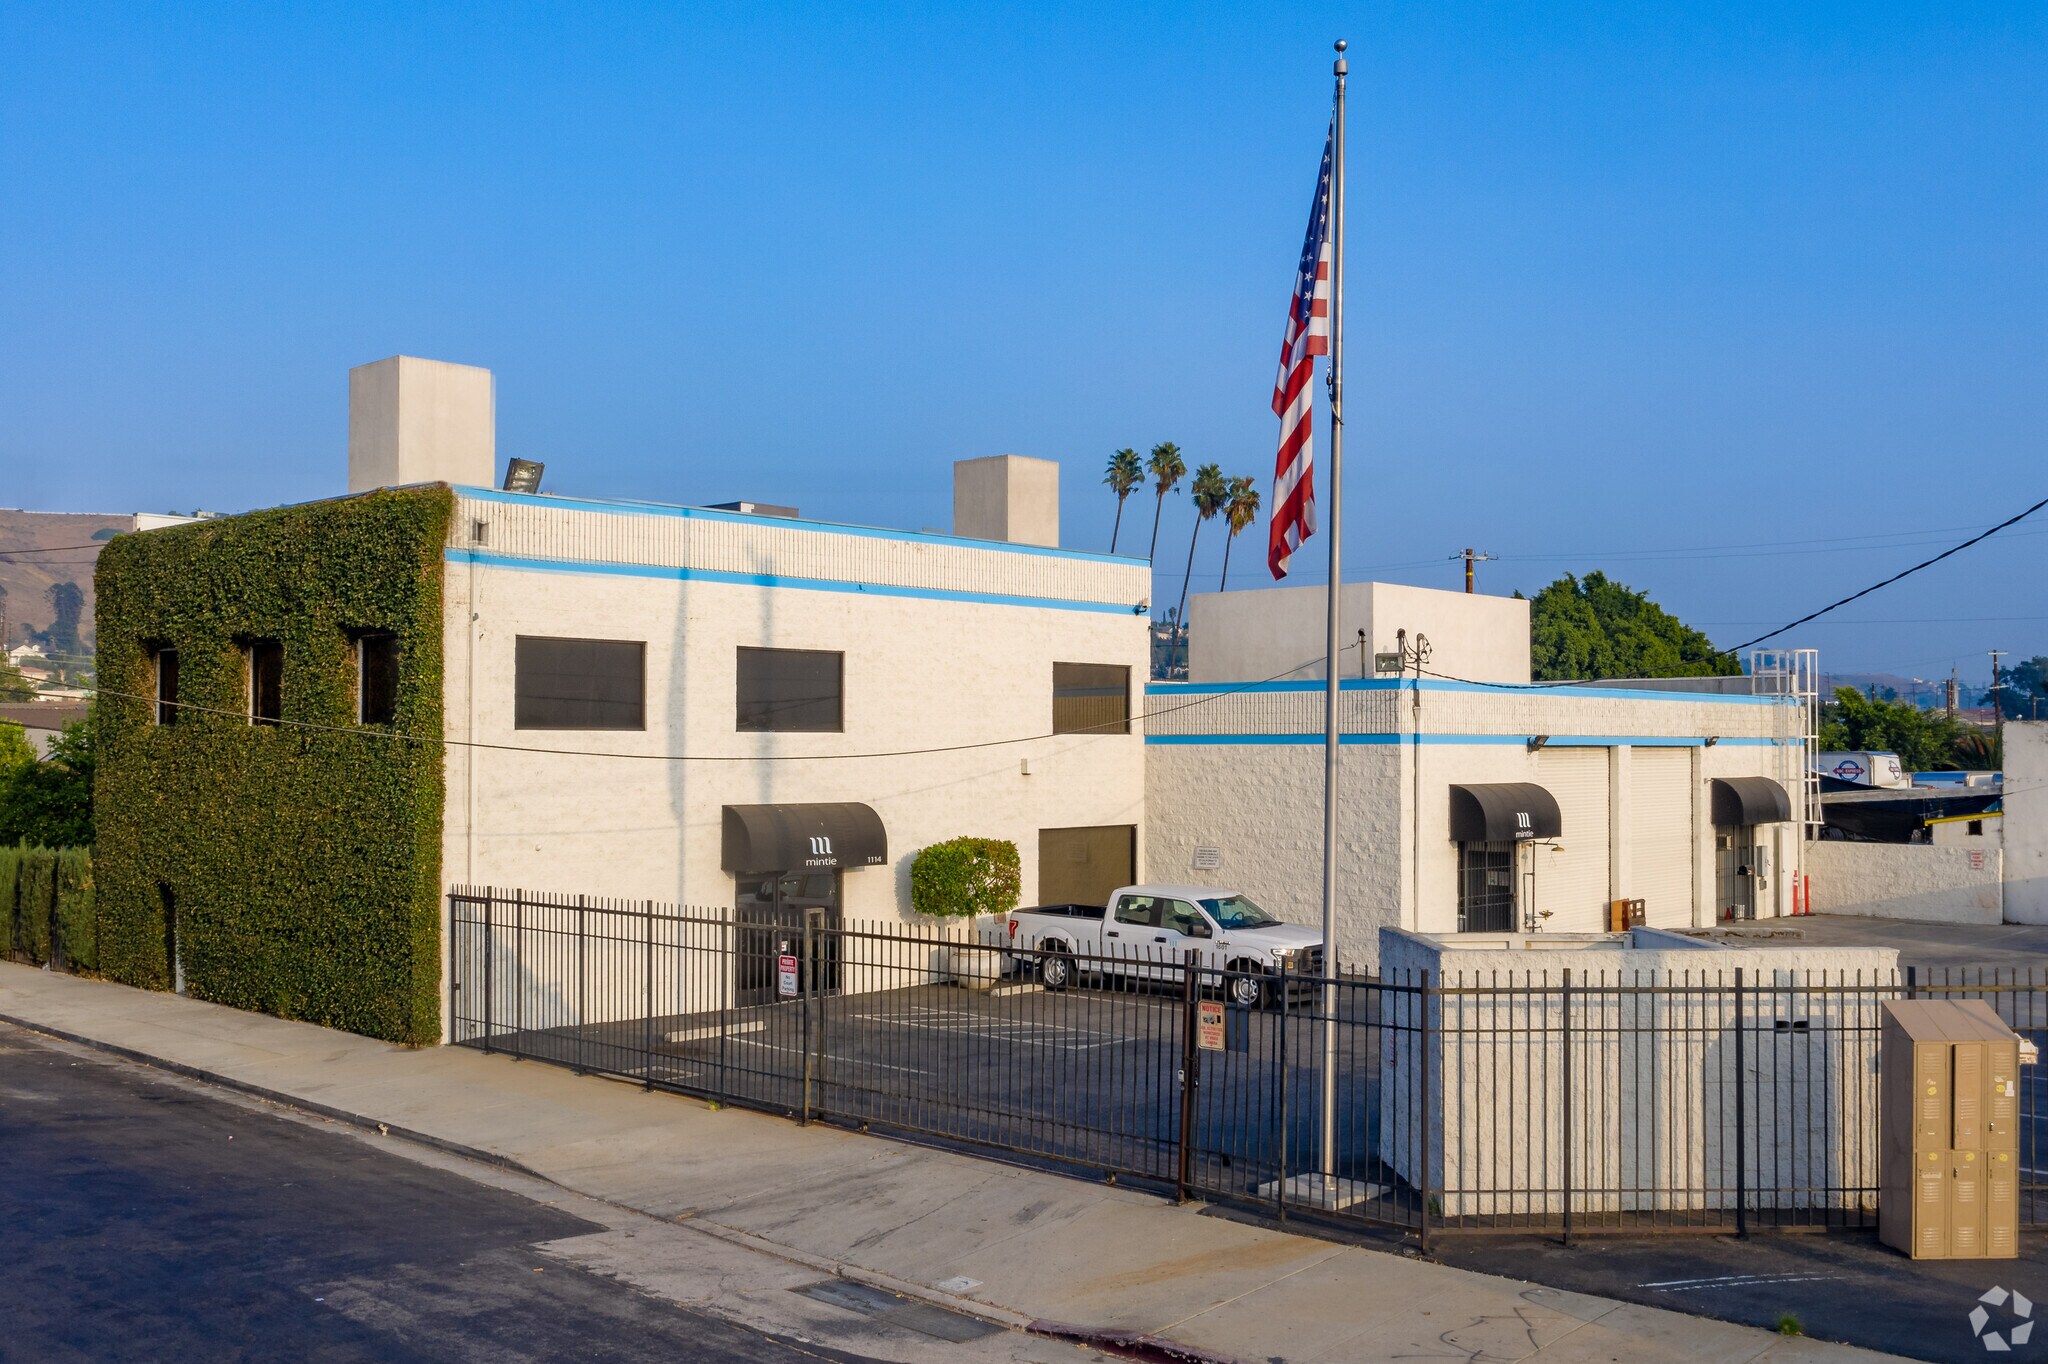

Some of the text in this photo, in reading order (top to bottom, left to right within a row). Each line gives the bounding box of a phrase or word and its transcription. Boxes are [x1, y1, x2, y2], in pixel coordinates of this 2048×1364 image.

[1515, 829, 1534, 838] mintie
[805, 857, 838, 867] mintie
[867, 856, 882, 864] 1114
[1201, 1005, 1221, 1013] NOTICE
